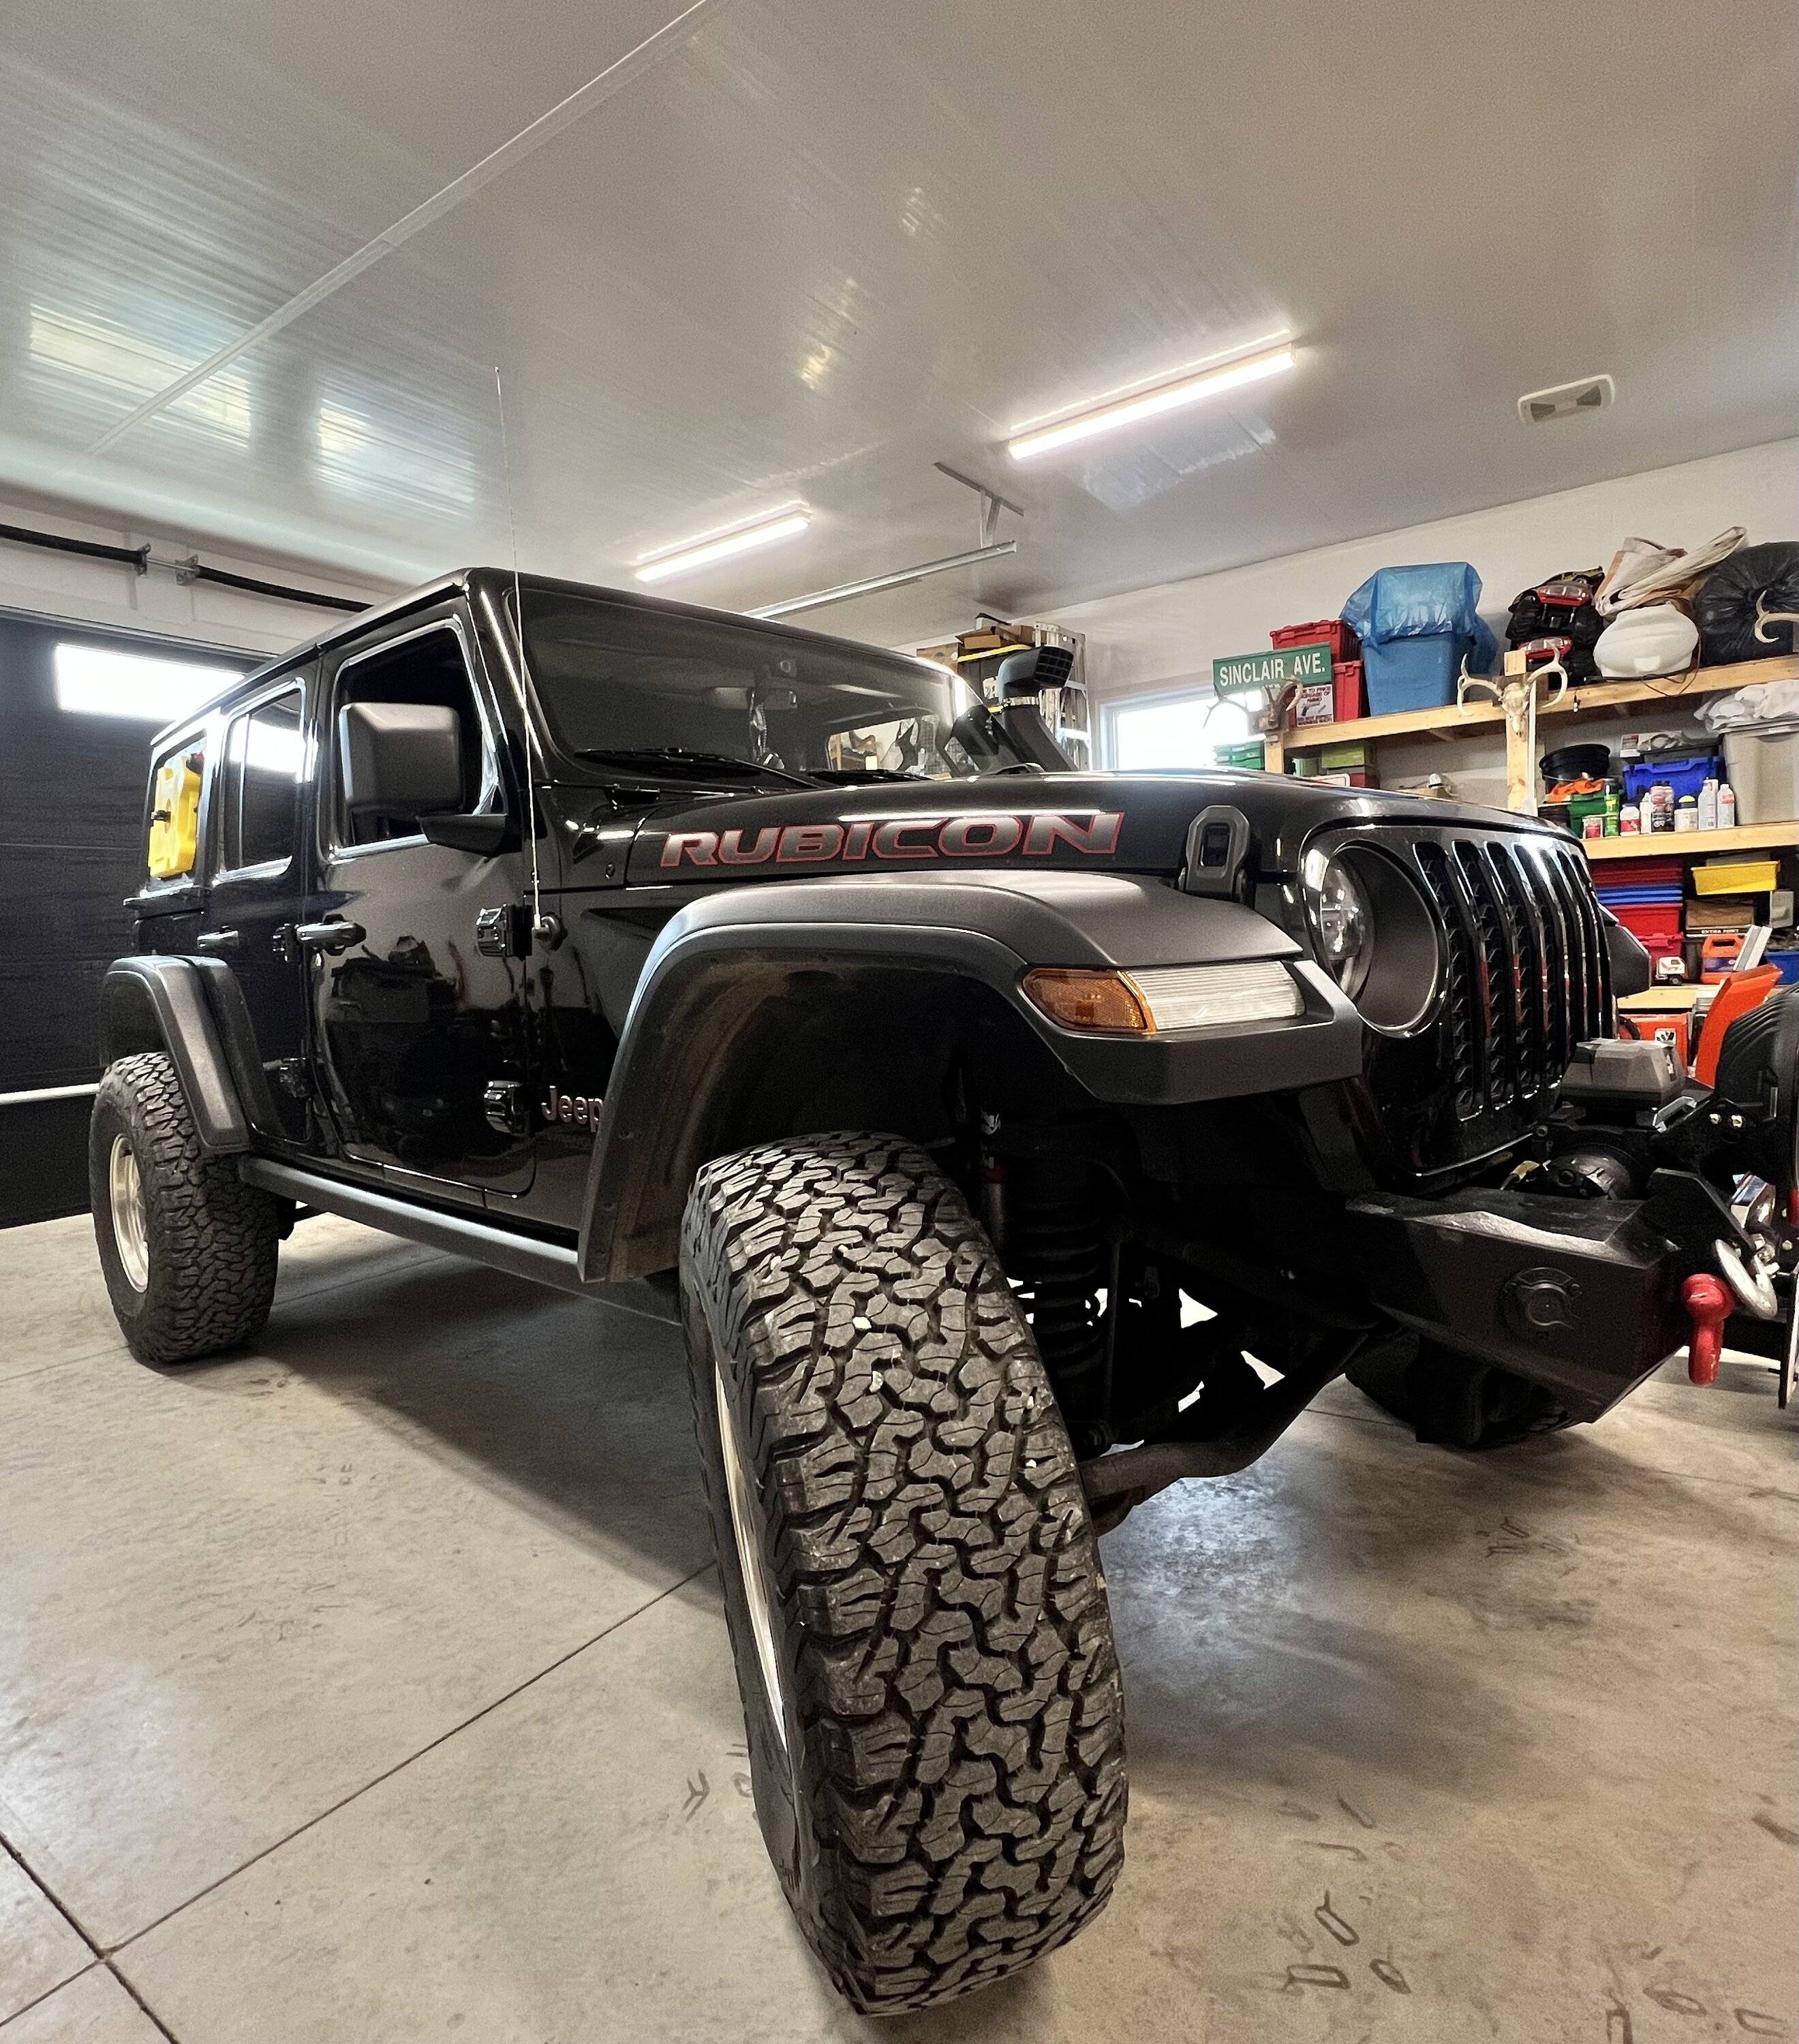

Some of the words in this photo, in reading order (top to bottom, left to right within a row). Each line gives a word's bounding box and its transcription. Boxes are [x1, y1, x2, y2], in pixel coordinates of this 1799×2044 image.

[1220, 658, 1285, 687] SINCLAIR
[1293, 653, 1325, 675] AVE.
[660, 811, 1125, 867] RUBICON
[541, 1085, 604, 1132] Jeep
